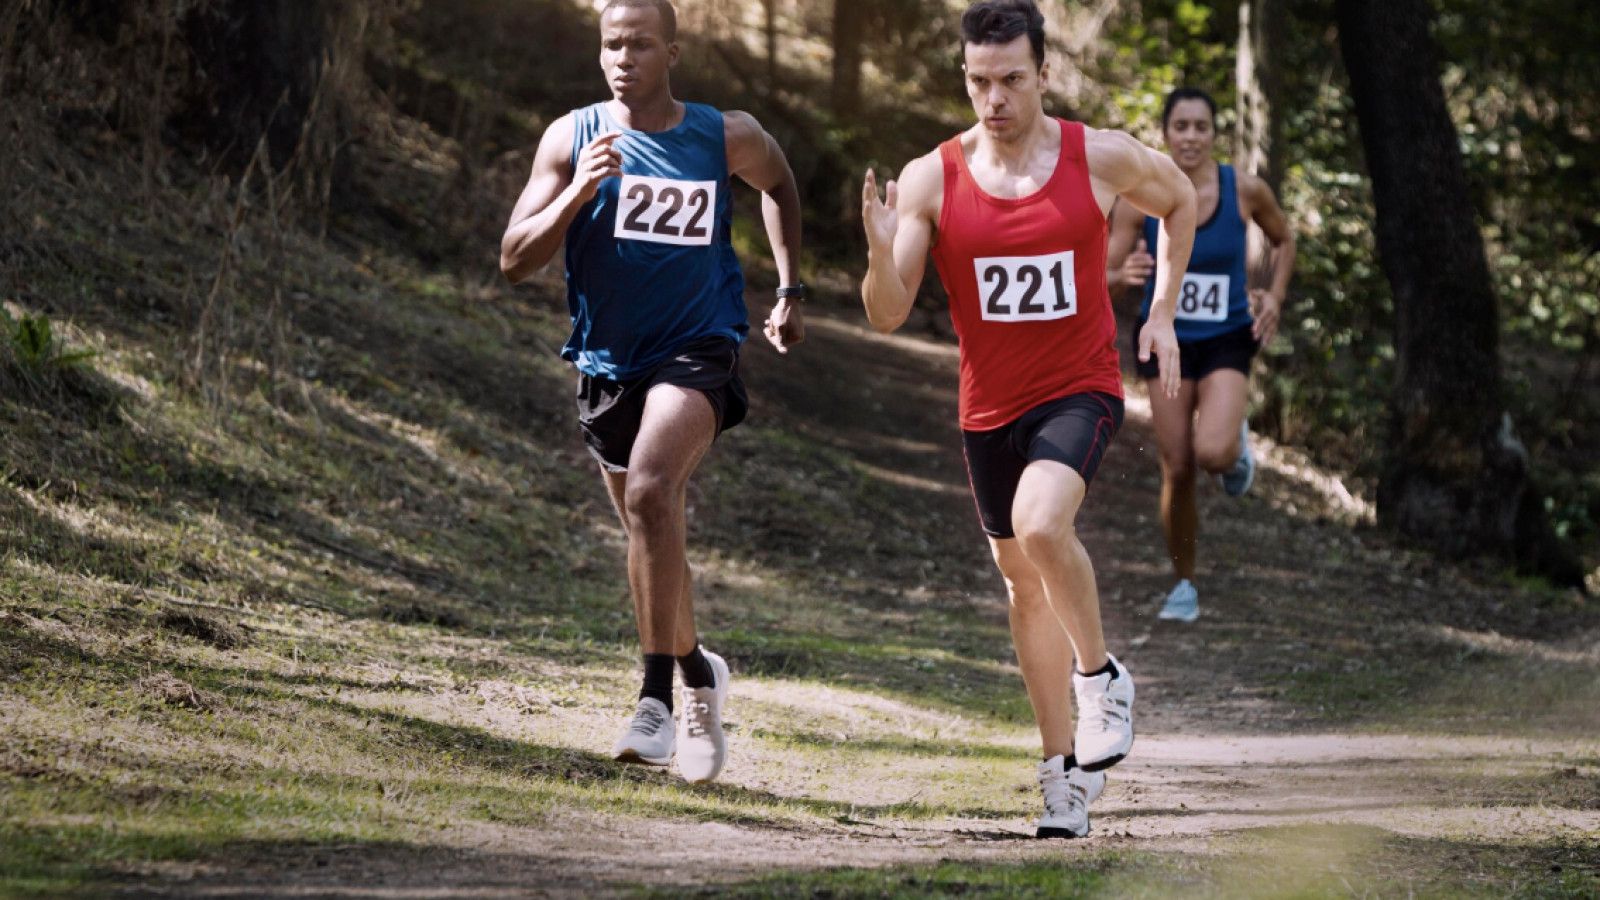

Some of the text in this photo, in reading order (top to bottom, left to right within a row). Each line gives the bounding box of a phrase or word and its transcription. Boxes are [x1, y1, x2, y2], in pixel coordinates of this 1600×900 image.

[623, 183, 709, 237] 222
[983, 261, 1070, 314] 221
[1176, 281, 1220, 314] 84
